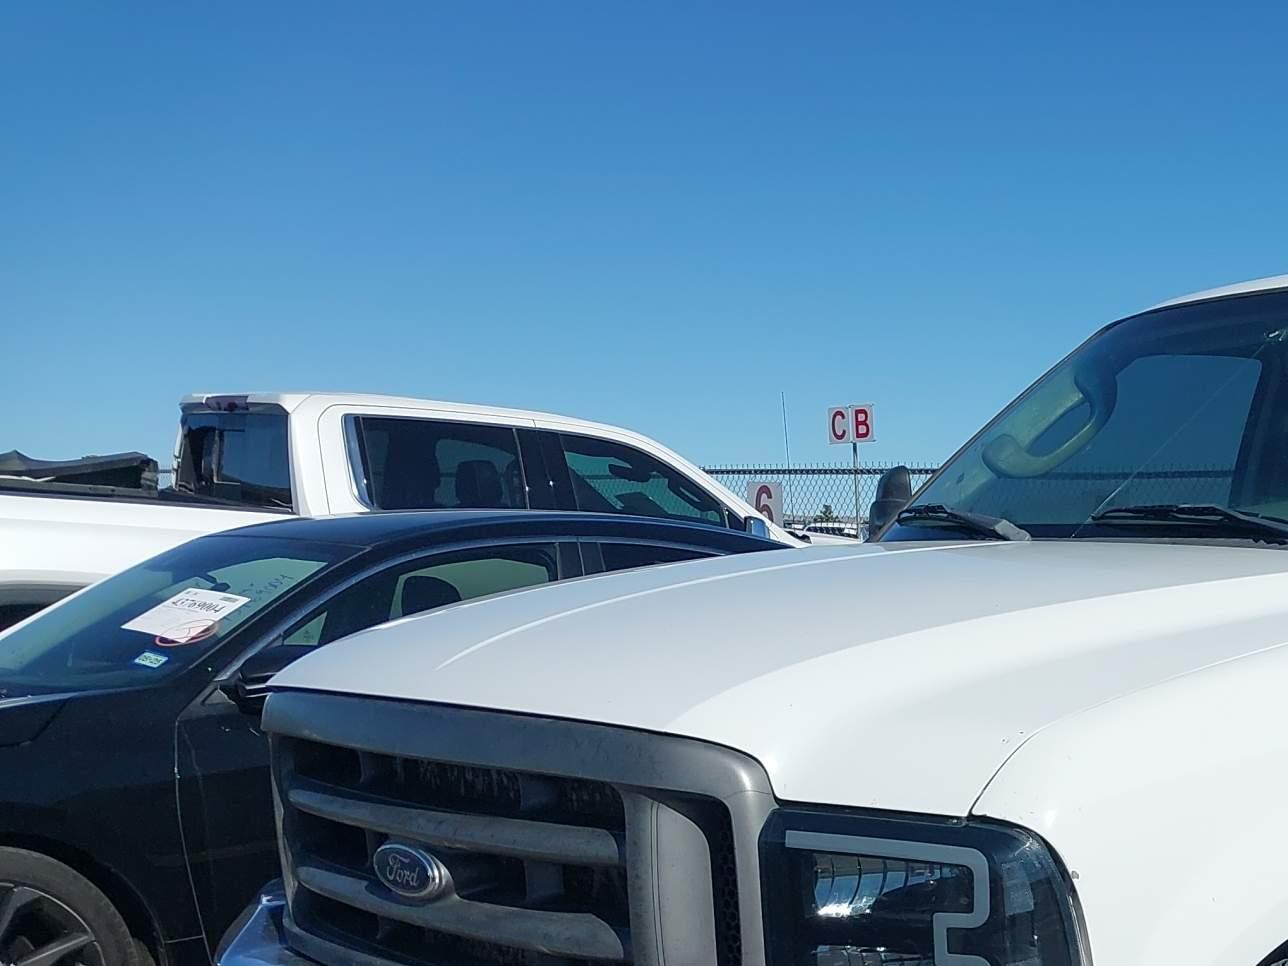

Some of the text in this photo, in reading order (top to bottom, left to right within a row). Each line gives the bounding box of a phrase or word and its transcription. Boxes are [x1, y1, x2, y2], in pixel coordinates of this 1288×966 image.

[831, 408, 870, 440] C B
[755, 485, 774, 522] 6
[386, 853, 420, 887] Ford
